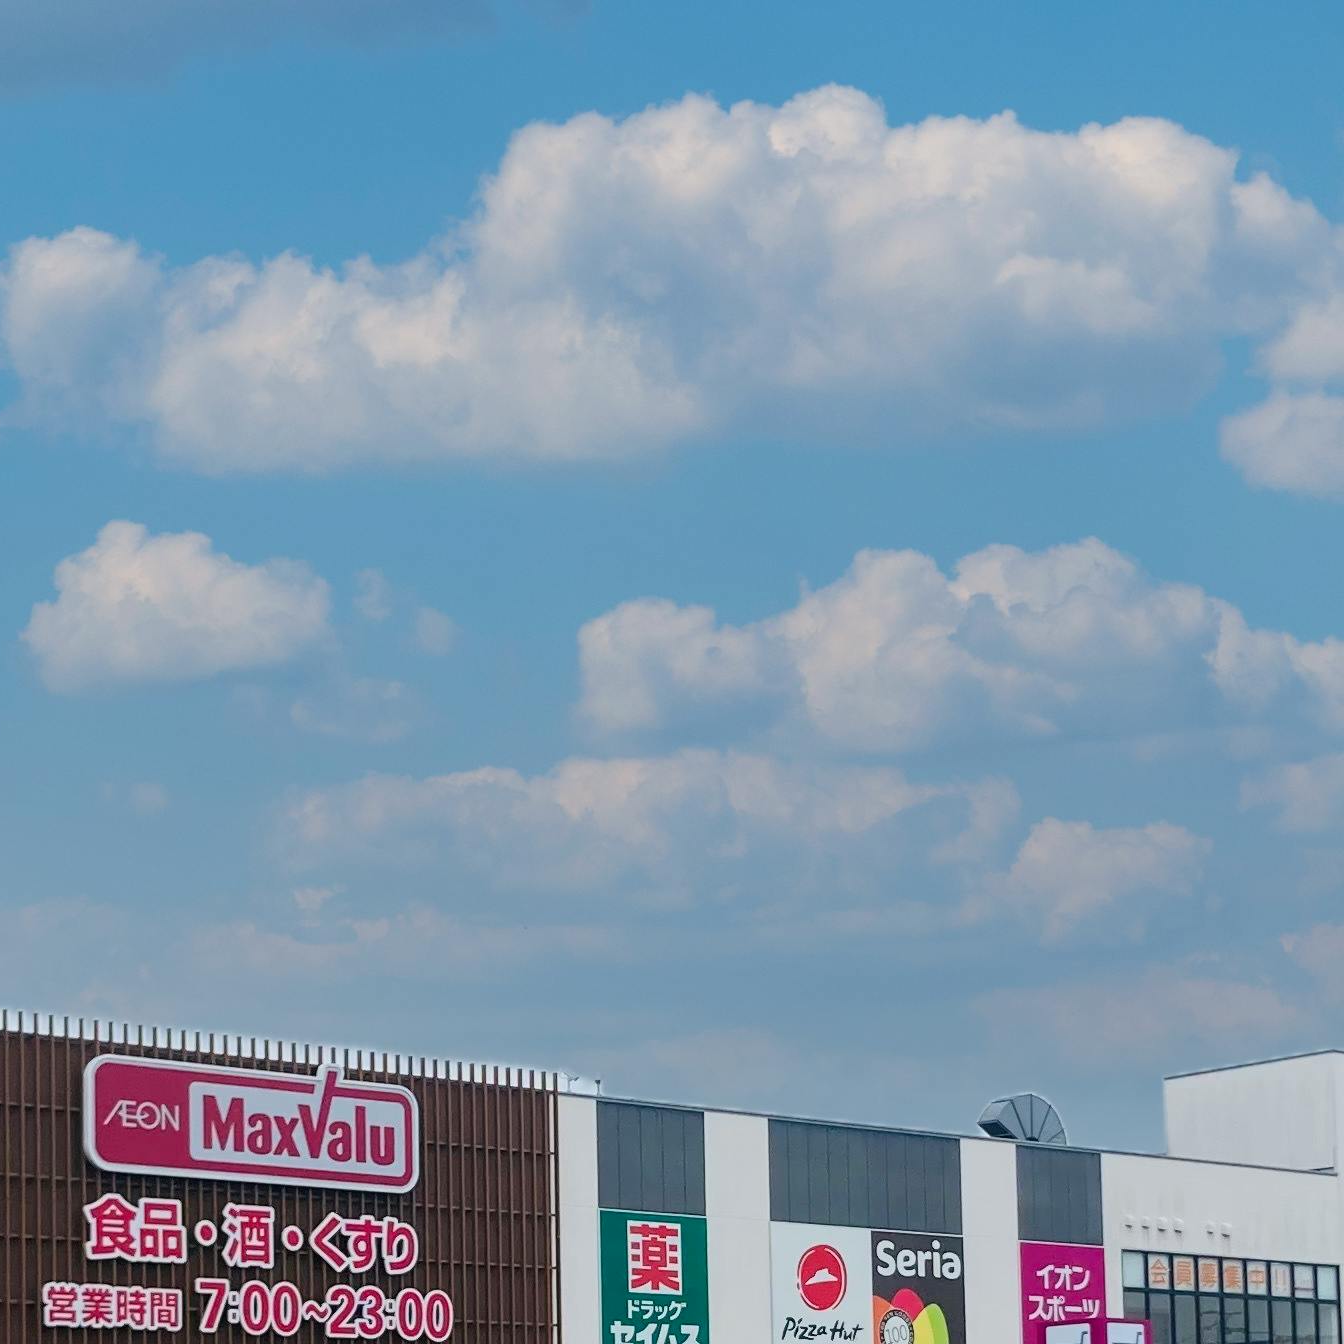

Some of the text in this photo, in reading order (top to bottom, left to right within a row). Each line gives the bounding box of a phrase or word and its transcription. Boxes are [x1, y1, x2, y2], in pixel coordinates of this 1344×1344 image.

[202, 1068, 395, 1166] MaxValu
[631, 1224, 682, 1293] 薬
[876, 1240, 962, 1280] Seria
[1036, 1264, 1091, 1291] イオン
[44, 1283, 183, 1331] 営業時間
[626, 1300, 686, 1321] ドラッグ
[1028, 1295, 1100, 1322] スポーツ
[781, 1316, 827, 1341] Pizza
[829, 1319, 864, 1342] Hut
[885, 1325, 908, 1344] 100
